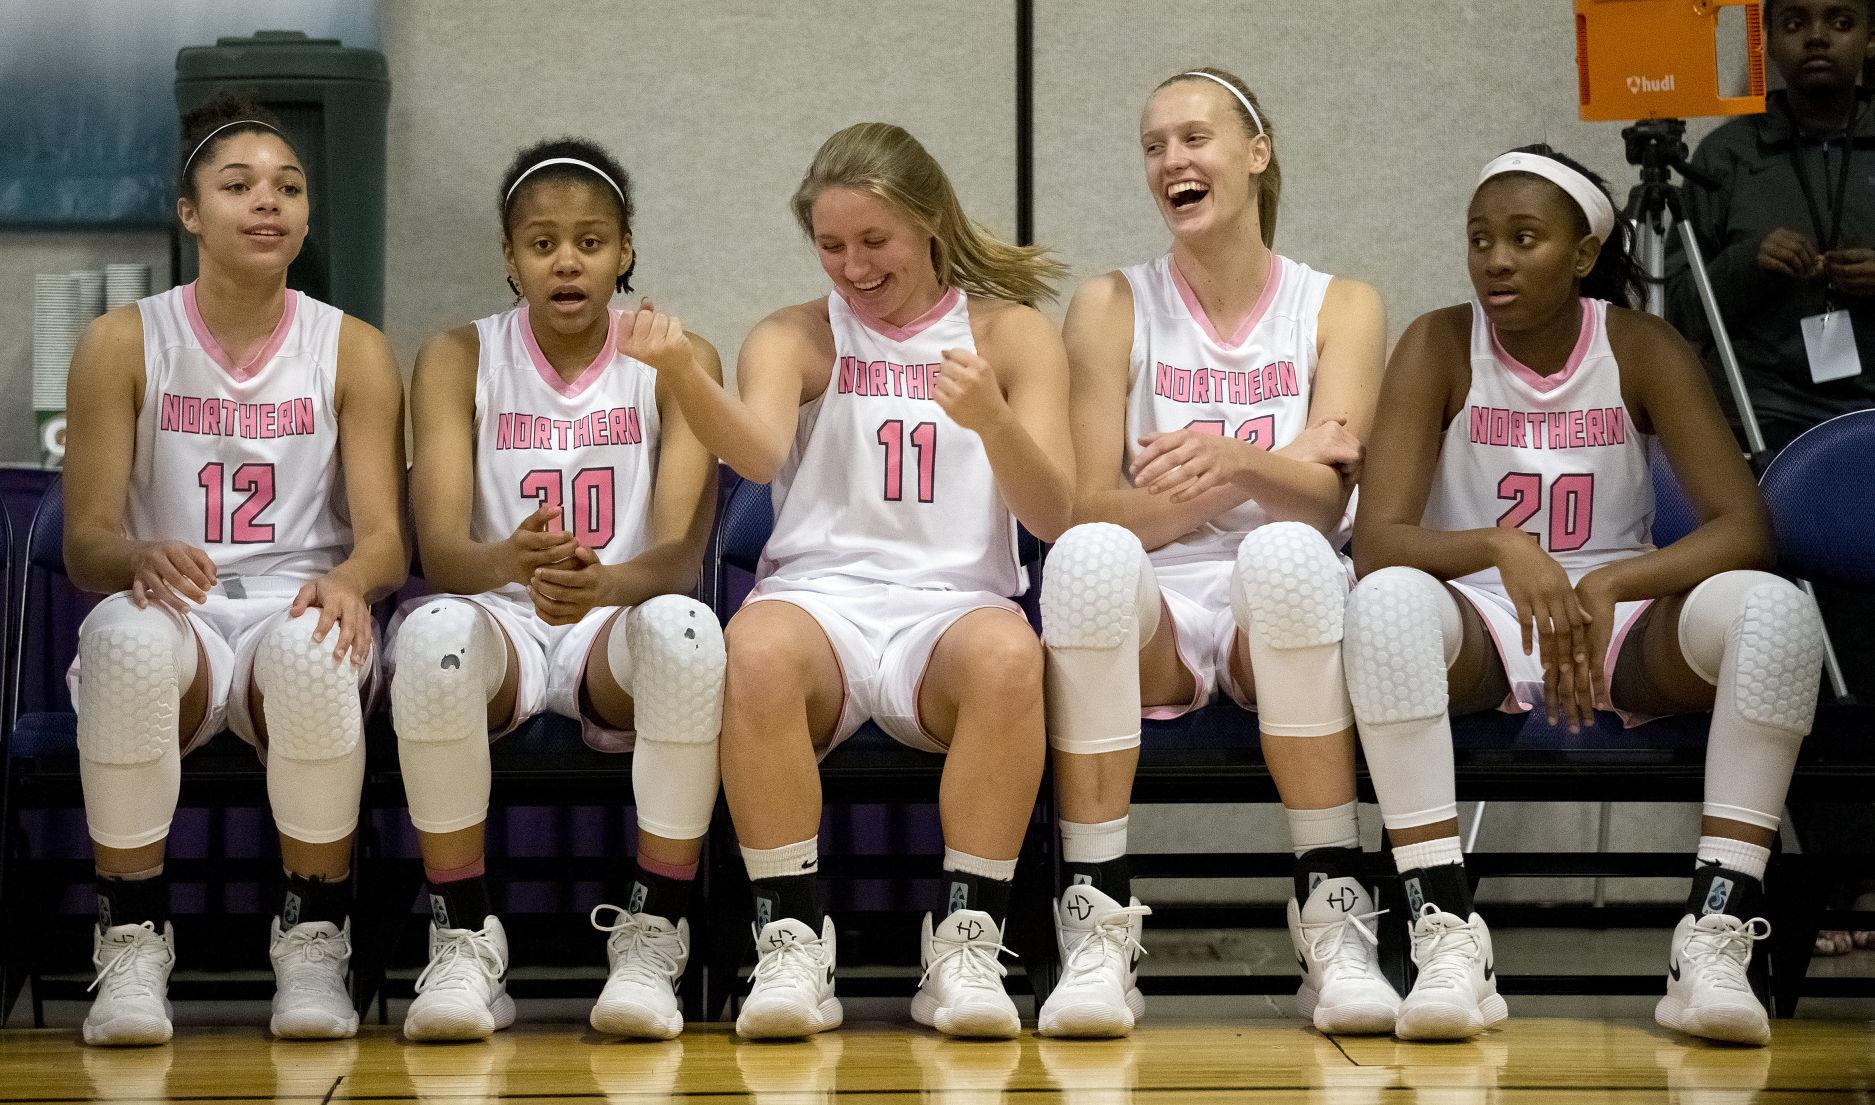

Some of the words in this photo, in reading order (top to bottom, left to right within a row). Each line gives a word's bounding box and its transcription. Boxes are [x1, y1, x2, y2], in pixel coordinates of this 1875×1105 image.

[1641, 74, 1675, 92] hudl
[838, 356, 942, 400] NORTHE
[1155, 361, 1299, 405] NORTHERN
[161, 393, 315, 439] NORTHERN
[496, 407, 642, 450] NORTHERN
[1471, 406, 1625, 449] NORTHERN
[877, 419, 936, 503] 11
[198, 462, 276, 544] 12
[1496, 472, 1594, 552] 20
